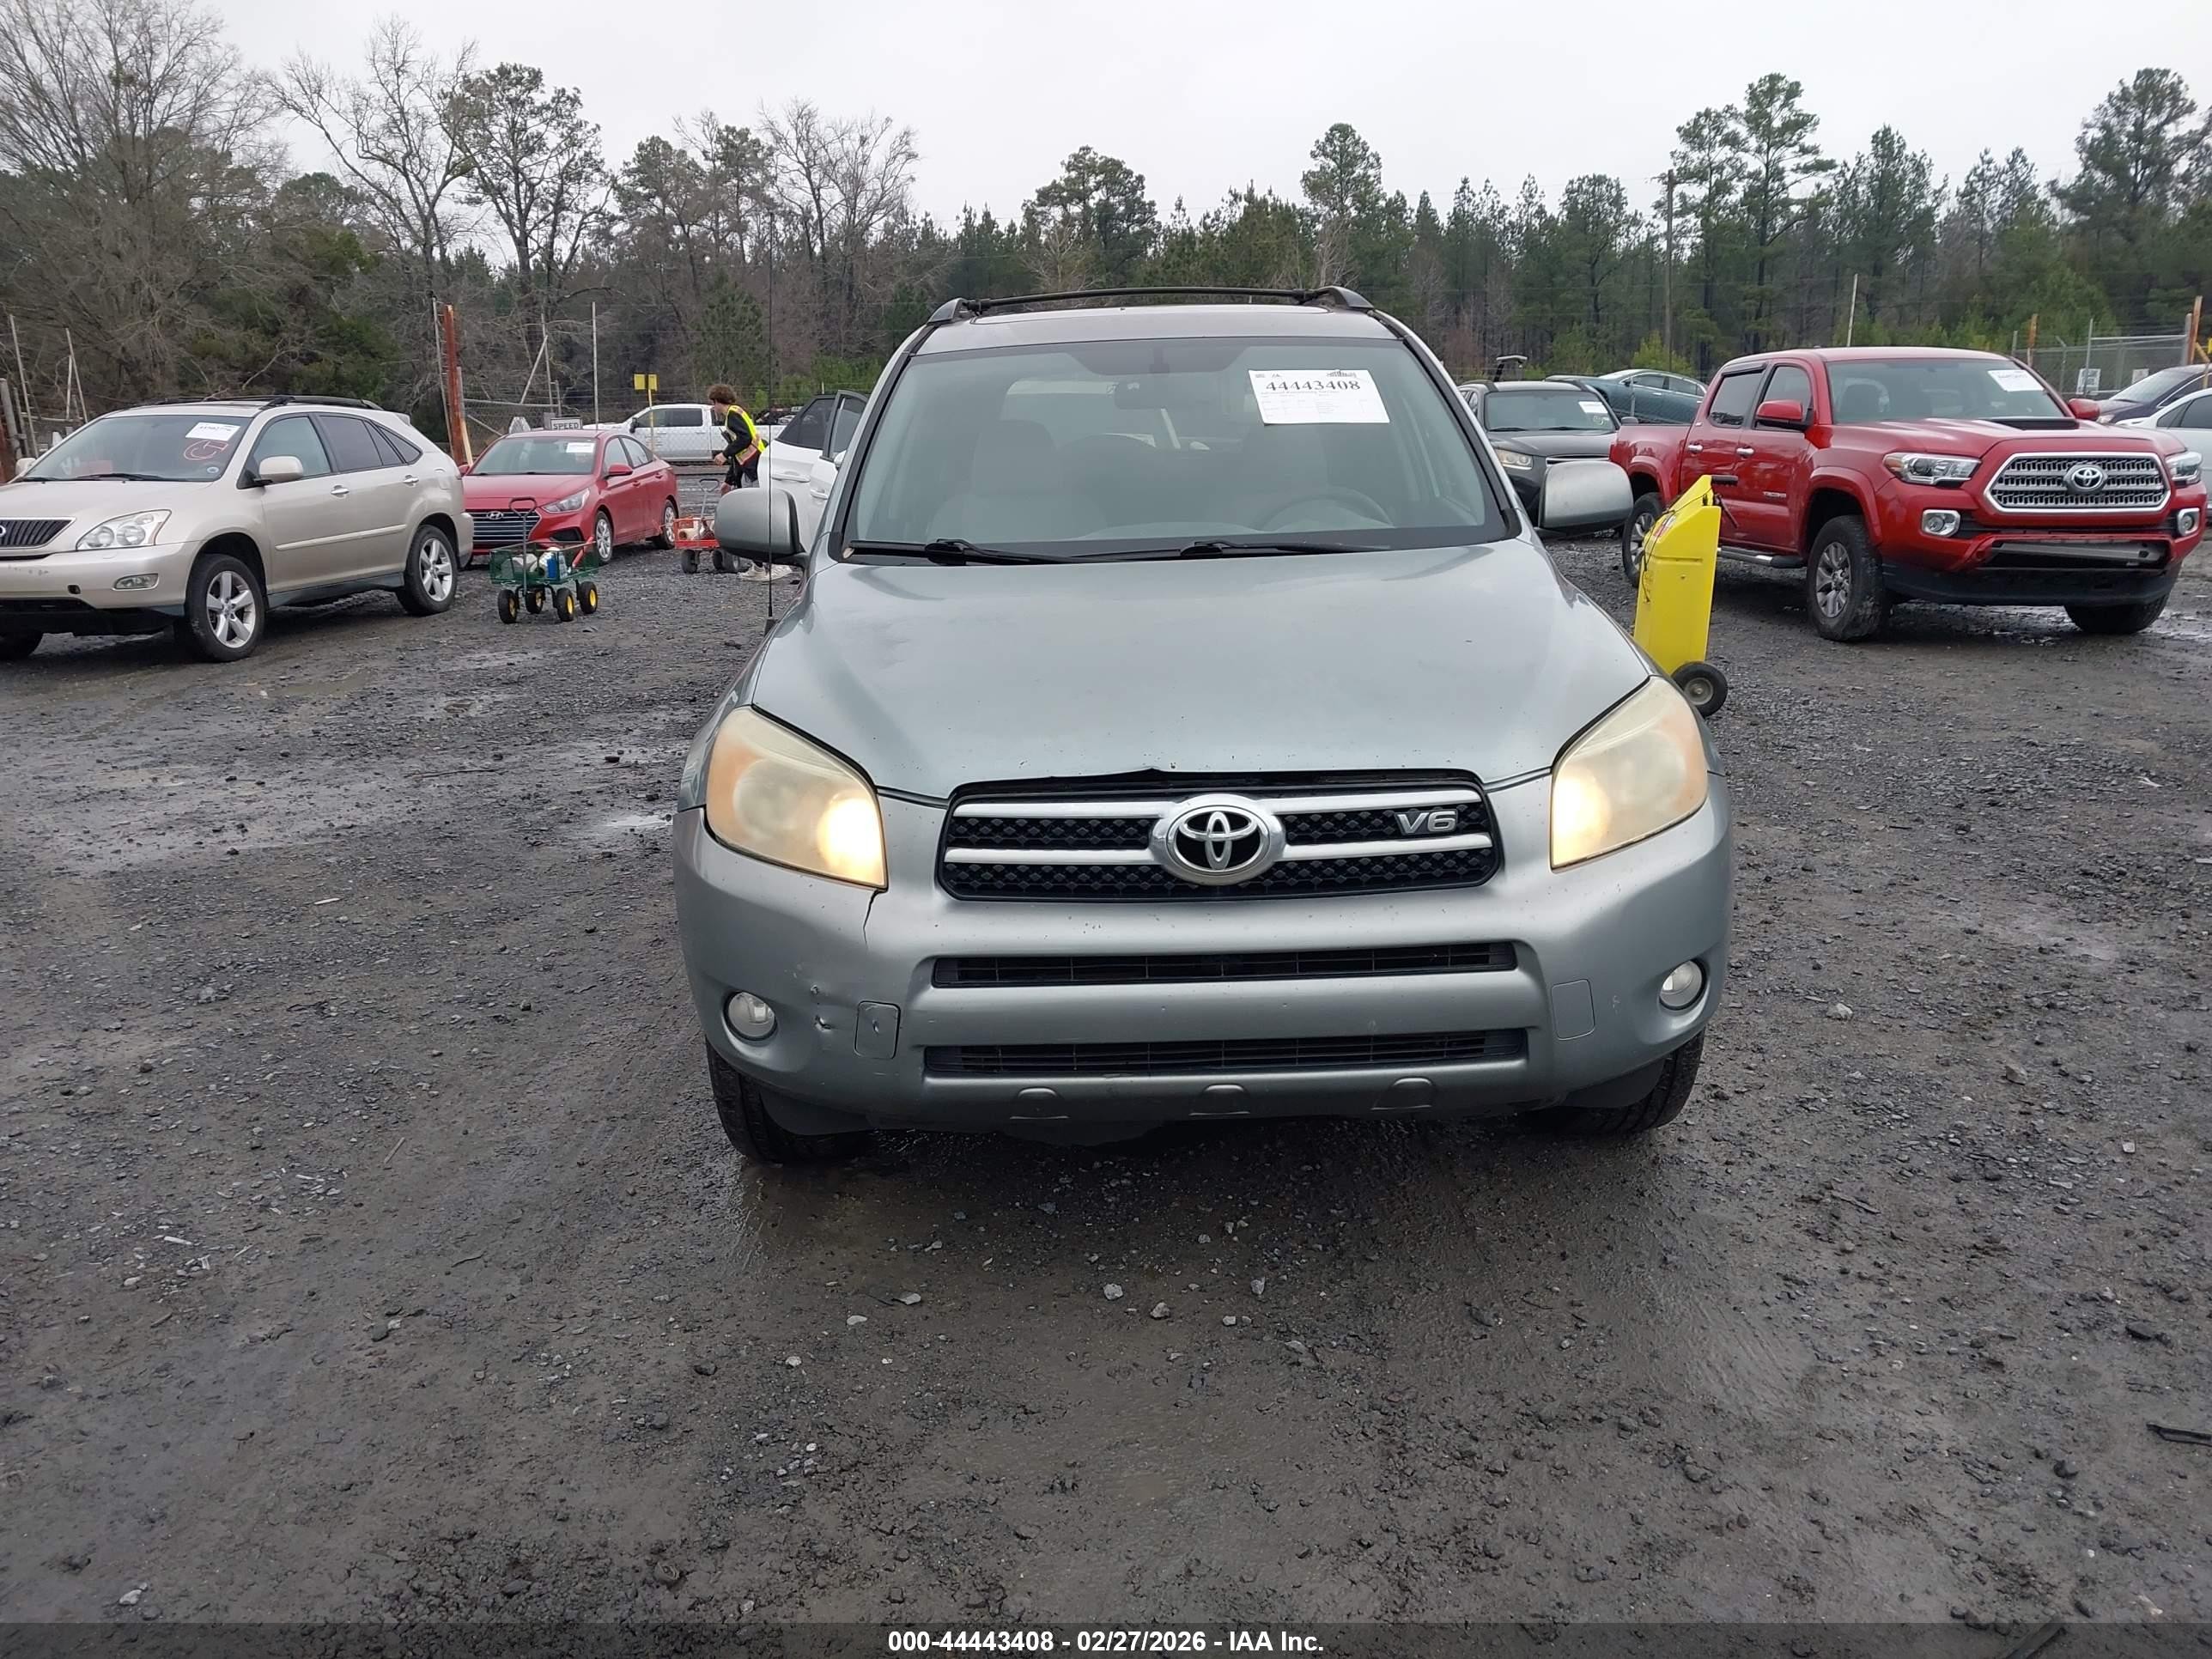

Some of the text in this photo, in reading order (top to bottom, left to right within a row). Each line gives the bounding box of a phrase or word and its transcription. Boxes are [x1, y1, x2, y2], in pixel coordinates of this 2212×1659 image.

[1266, 380, 1361, 392] 44443408
[553, 422, 580, 430] SPEED
[1396, 810, 1456, 834] V6
